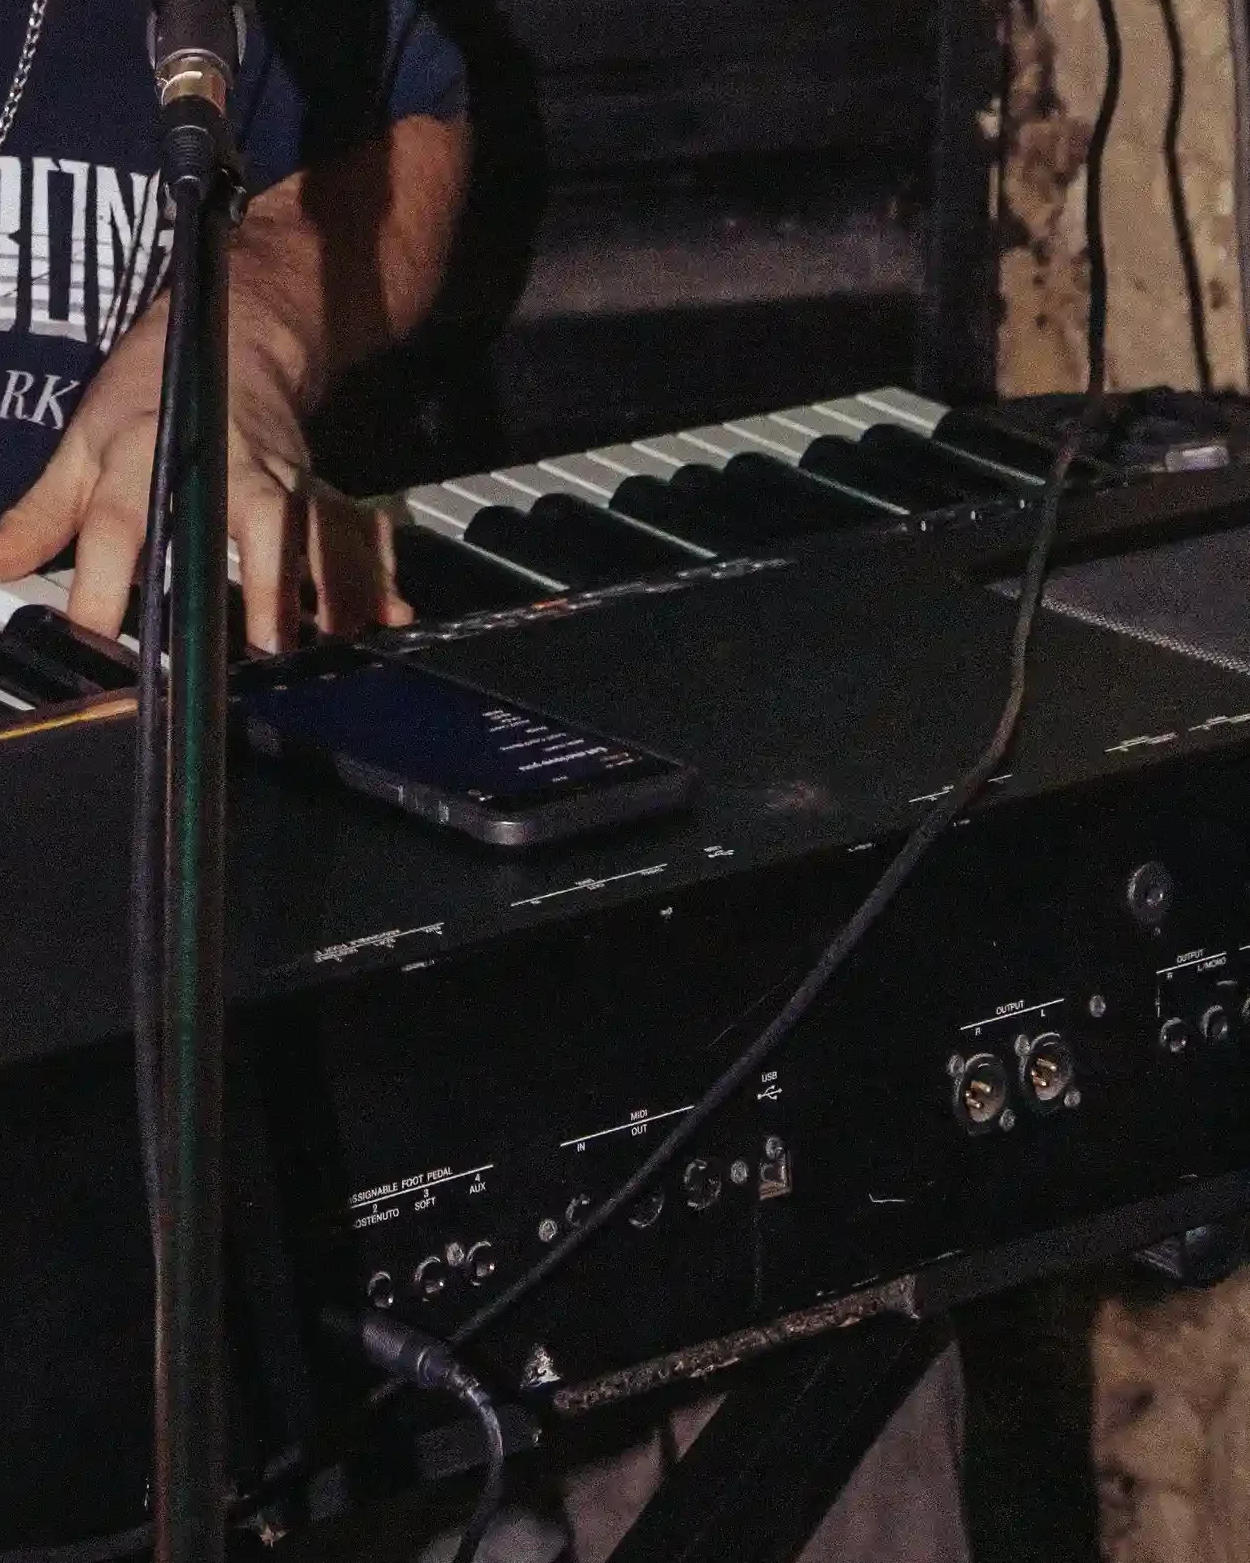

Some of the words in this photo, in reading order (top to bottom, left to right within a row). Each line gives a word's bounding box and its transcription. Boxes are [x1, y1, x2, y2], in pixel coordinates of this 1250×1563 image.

[1176, 948, 1204, 964] OUTPUT
[995, 999, 1025, 1015] OUTPUT
[1040, 1008, 1046, 1018] L
[761, 1070, 778, 1083] USB
[630, 1109, 649, 1122] MIDI
[576, 1141, 586, 1153] IN
[631, 1123, 648, 1137] OUT
[401, 1174, 425, 1189] FOOT
[427, 1166, 454, 1182] PEDAL
[474, 1173, 481, 1182] 4
[423, 1189, 429, 1198] 3
[469, 1182, 487, 1195] AUX
[372, 1203, 378, 1214] 2
[414, 1197, 437, 1211] SOFT
